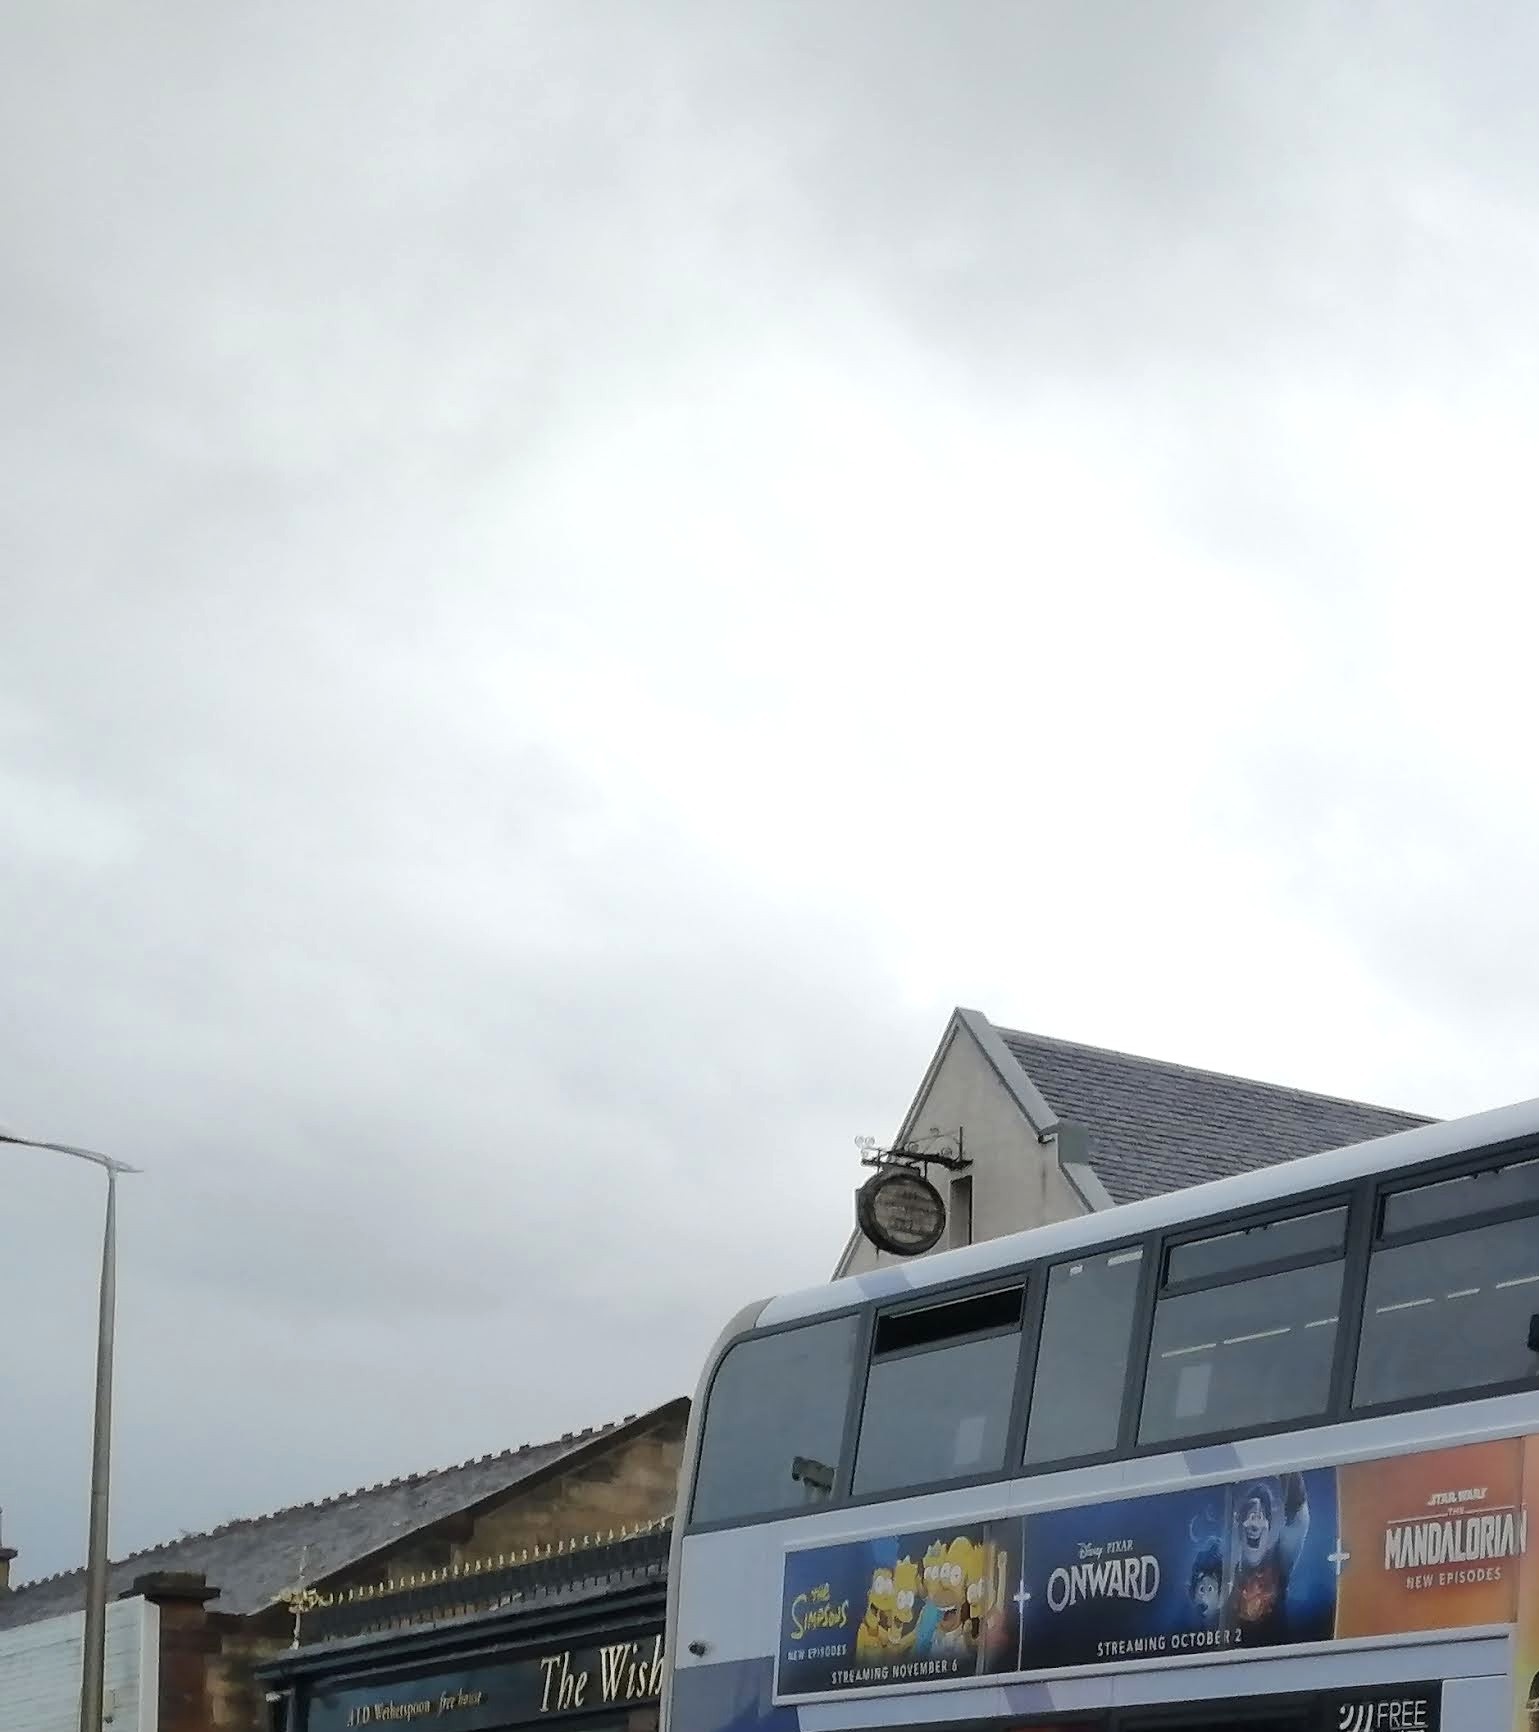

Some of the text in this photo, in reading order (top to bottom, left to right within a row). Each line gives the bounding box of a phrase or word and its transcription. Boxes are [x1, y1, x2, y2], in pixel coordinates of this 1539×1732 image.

[1427, 1488, 1488, 1506] STAR WARS
[1077, 1540, 1133, 1559] Disney PIXAR
[1385, 1510, 1527, 1570] MANDALORIAN
[1047, 1555, 1160, 1612] ONWARD
[1407, 1567, 1501, 1589] NEW EPISODES
[791, 1595, 849, 1640] SIMPSONS
[787, 1644, 848, 1661] NEW EPISODES
[1097, 1628, 1243, 1657] STREAMING OCTOBER 2
[540, 1651, 588, 1713] The
[832, 1658, 959, 1685] STREAMING NOVEMBER 6
[1376, 1700, 1427, 1729] FREE
